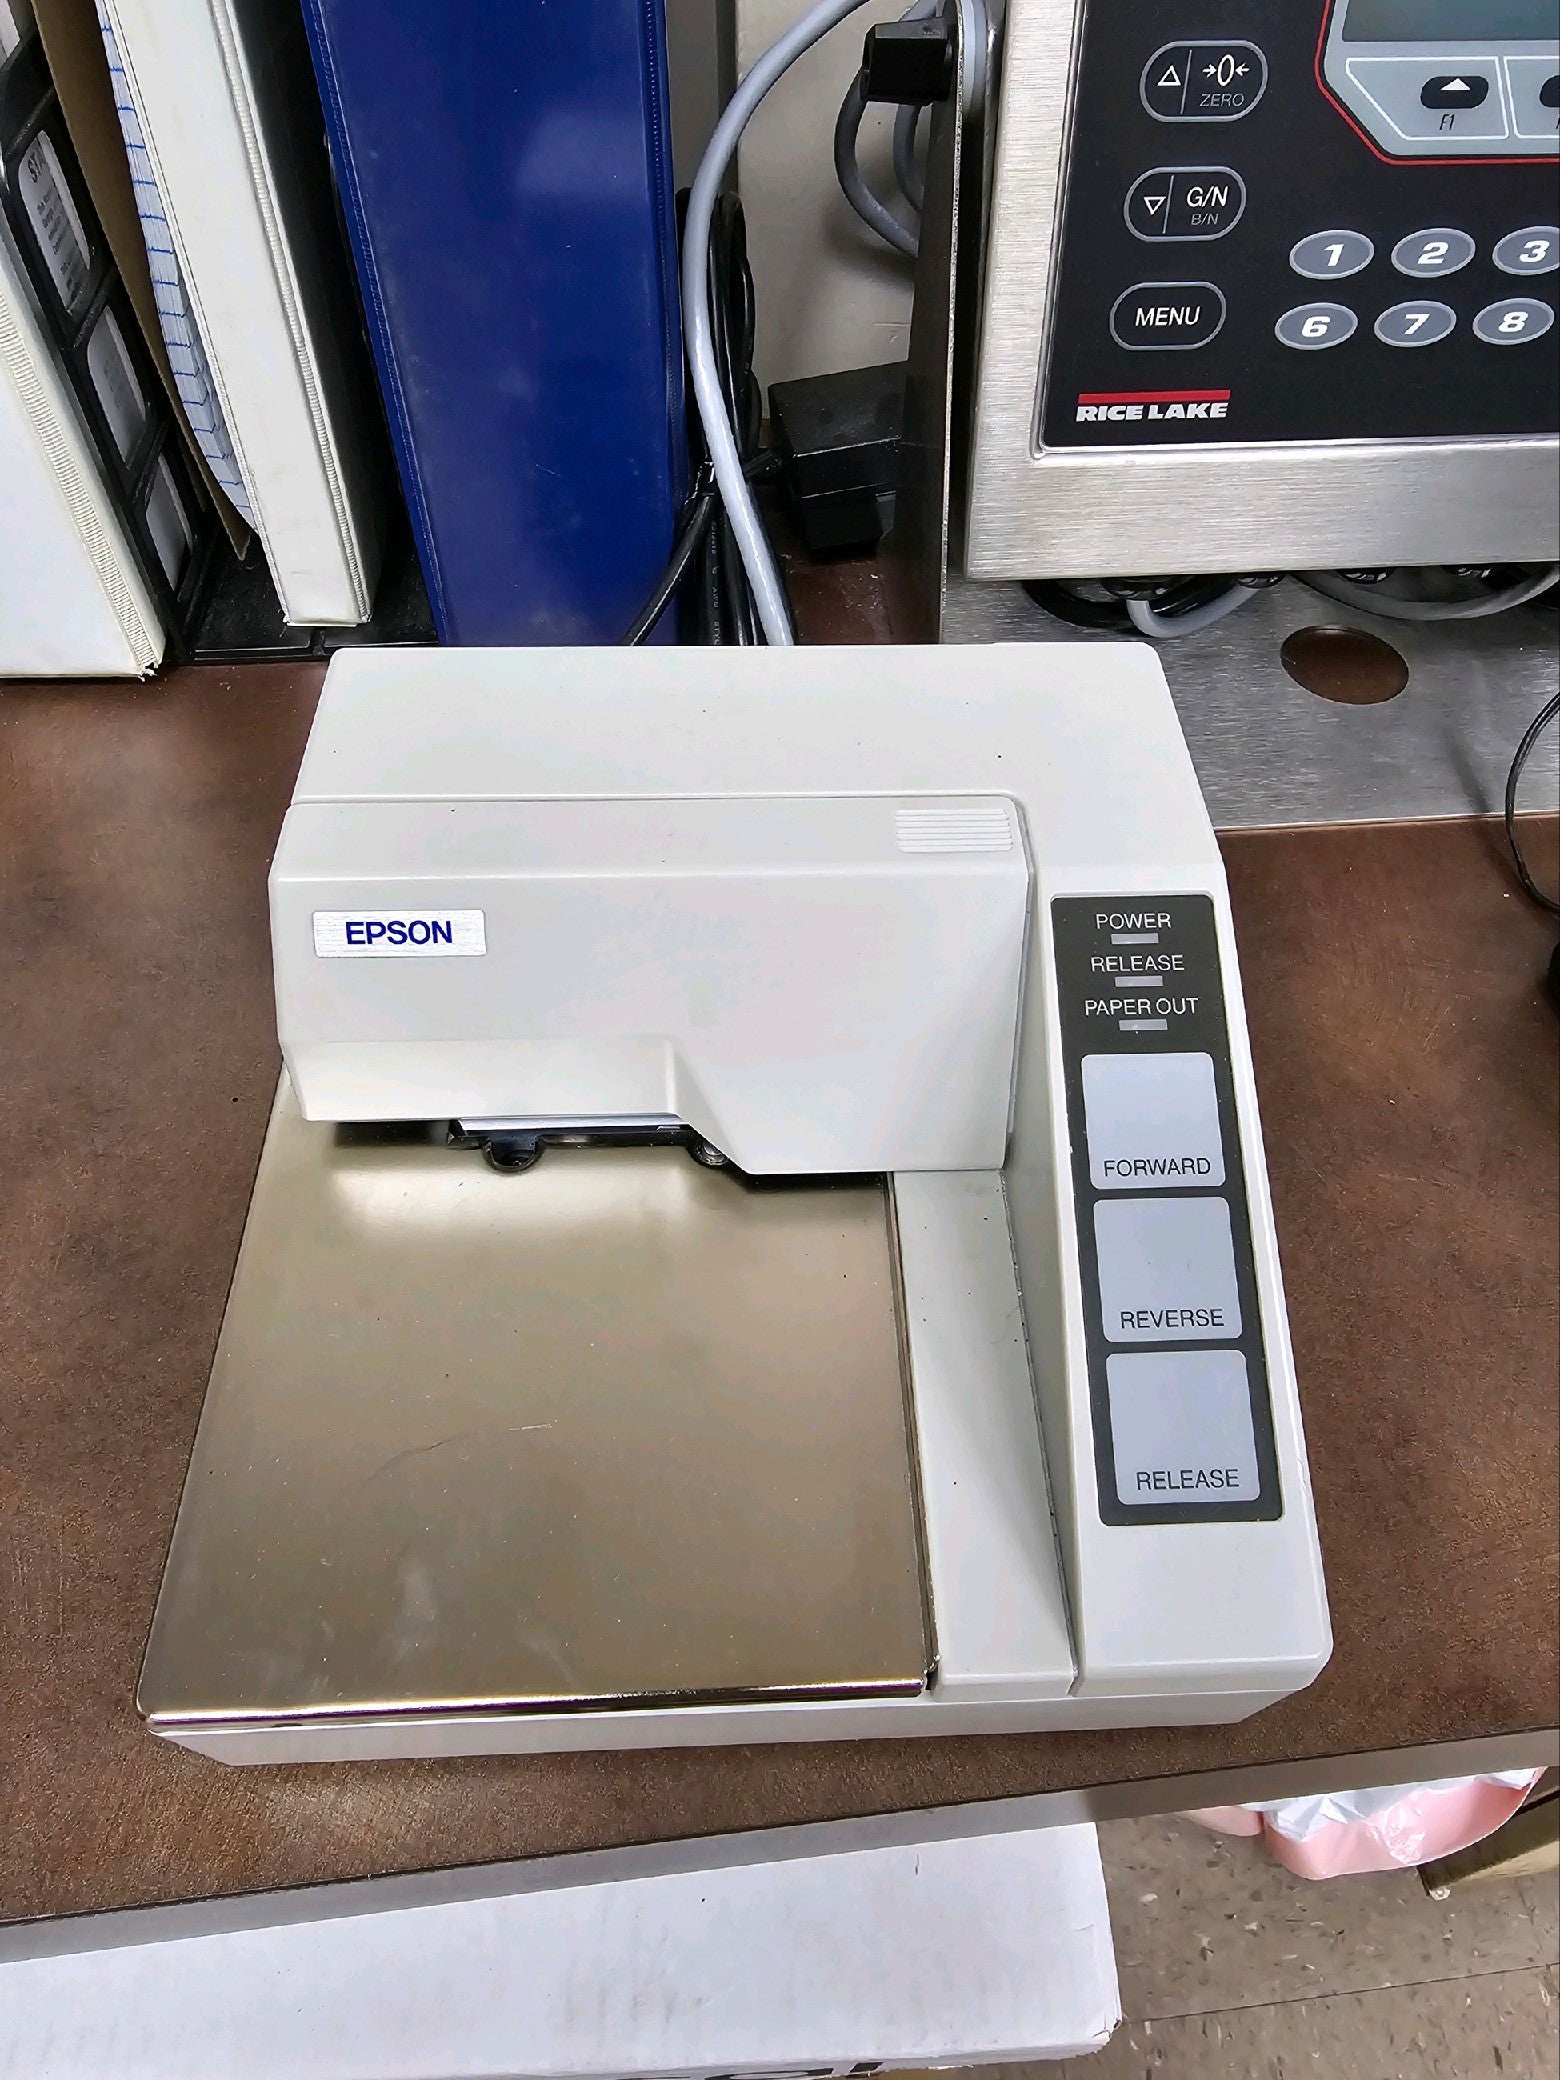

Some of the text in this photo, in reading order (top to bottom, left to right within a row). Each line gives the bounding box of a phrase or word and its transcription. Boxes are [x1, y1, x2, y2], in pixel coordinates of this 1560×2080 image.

[1199, 94, 1245, 108] ZERO
[1438, 114, 1456, 131] F1
[1187, 186, 1228, 207] G/N
[1191, 214, 1219, 226] B/N
[1324, 244, 1346, 267] 1
[1416, 242, 1450, 265] 2
[1518, 241, 1549, 263] 3
[1135, 306, 1201, 327] MENU
[1301, 315, 1332, 337] 6
[1403, 313, 1430, 335] 7
[1498, 312, 1530, 333] 8
[1075, 403, 1229, 422] RICE LAKE
[1096, 912, 1172, 930] POWER
[345, 920, 453, 945] EPSON
[1090, 954, 1185, 973] RELEASE
[1085, 997, 1199, 1016] PAPER OUT
[1103, 1157, 1212, 1178] FORWARD
[1120, 1308, 1225, 1330] REVERSE
[1136, 1468, 1240, 1491] RELEASE
